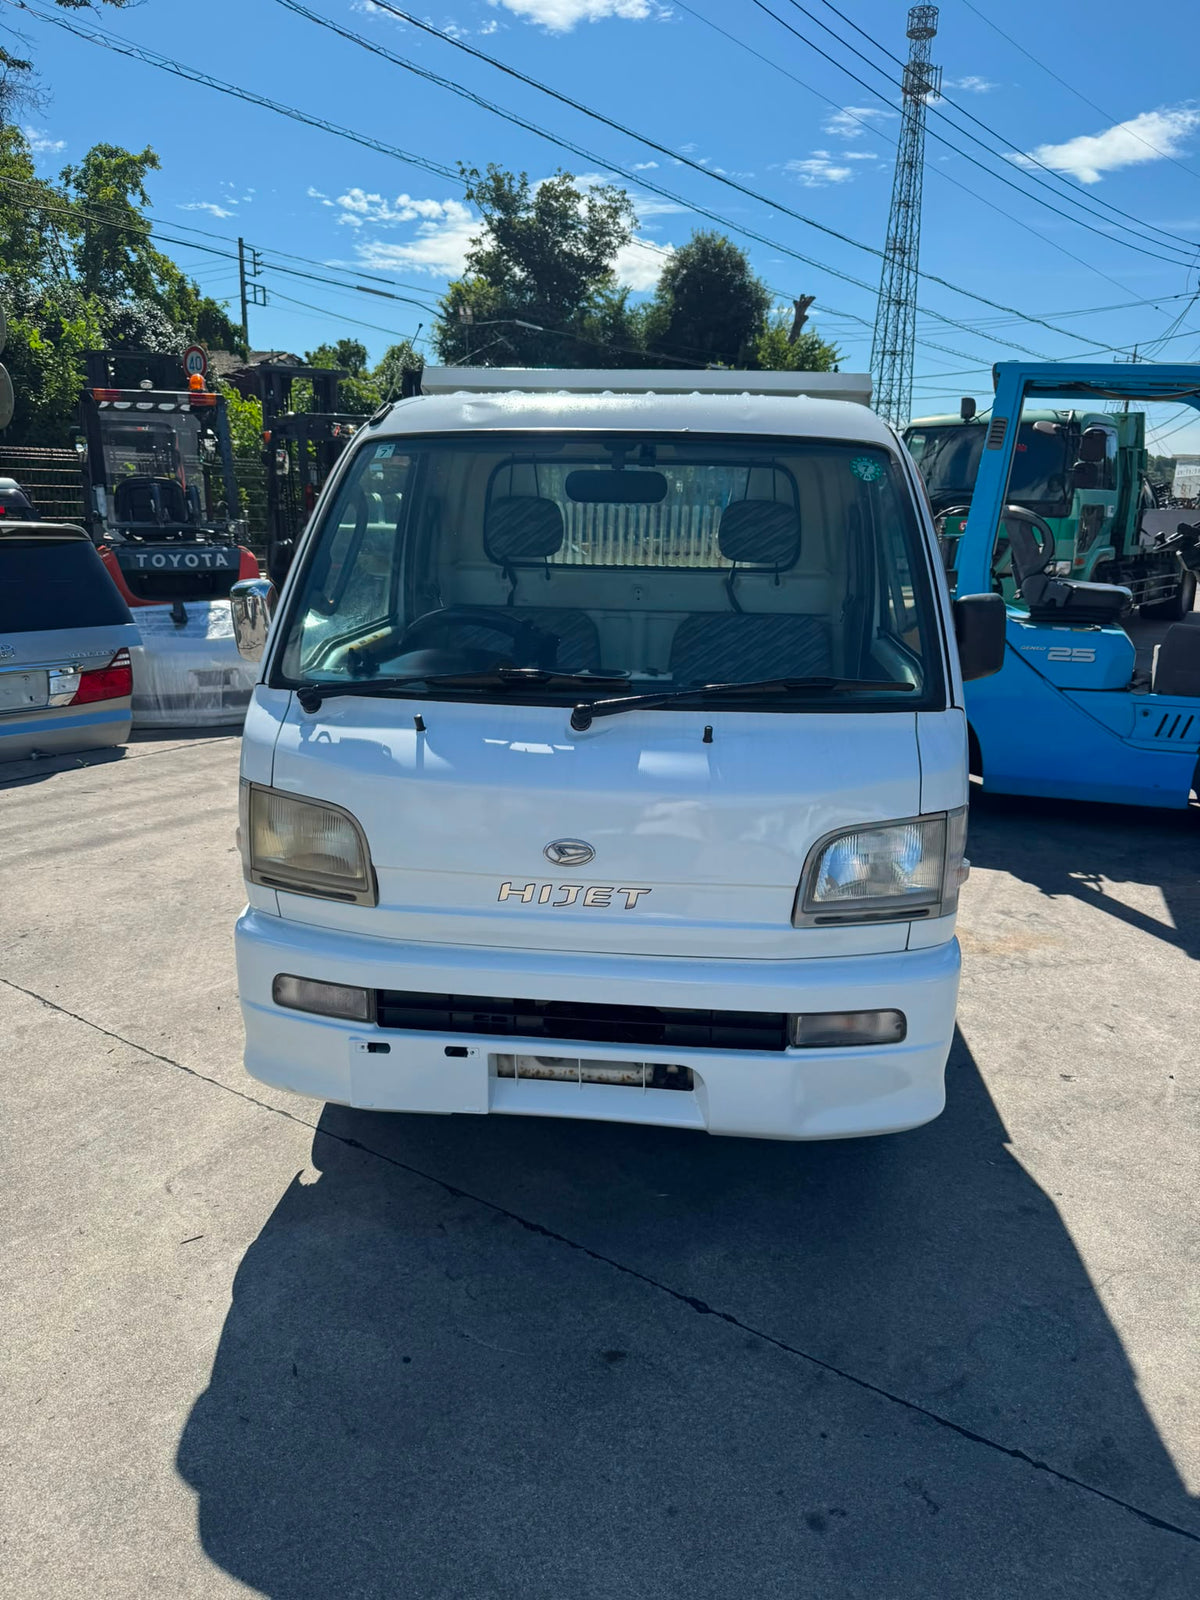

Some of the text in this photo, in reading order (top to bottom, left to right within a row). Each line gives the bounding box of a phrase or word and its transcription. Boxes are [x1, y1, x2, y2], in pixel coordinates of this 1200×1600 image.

[189, 356, 202, 371] 40
[135, 553, 229, 568] TOYOTA
[1047, 646, 1097, 663] 25
[497, 881, 652, 910] HIJET
